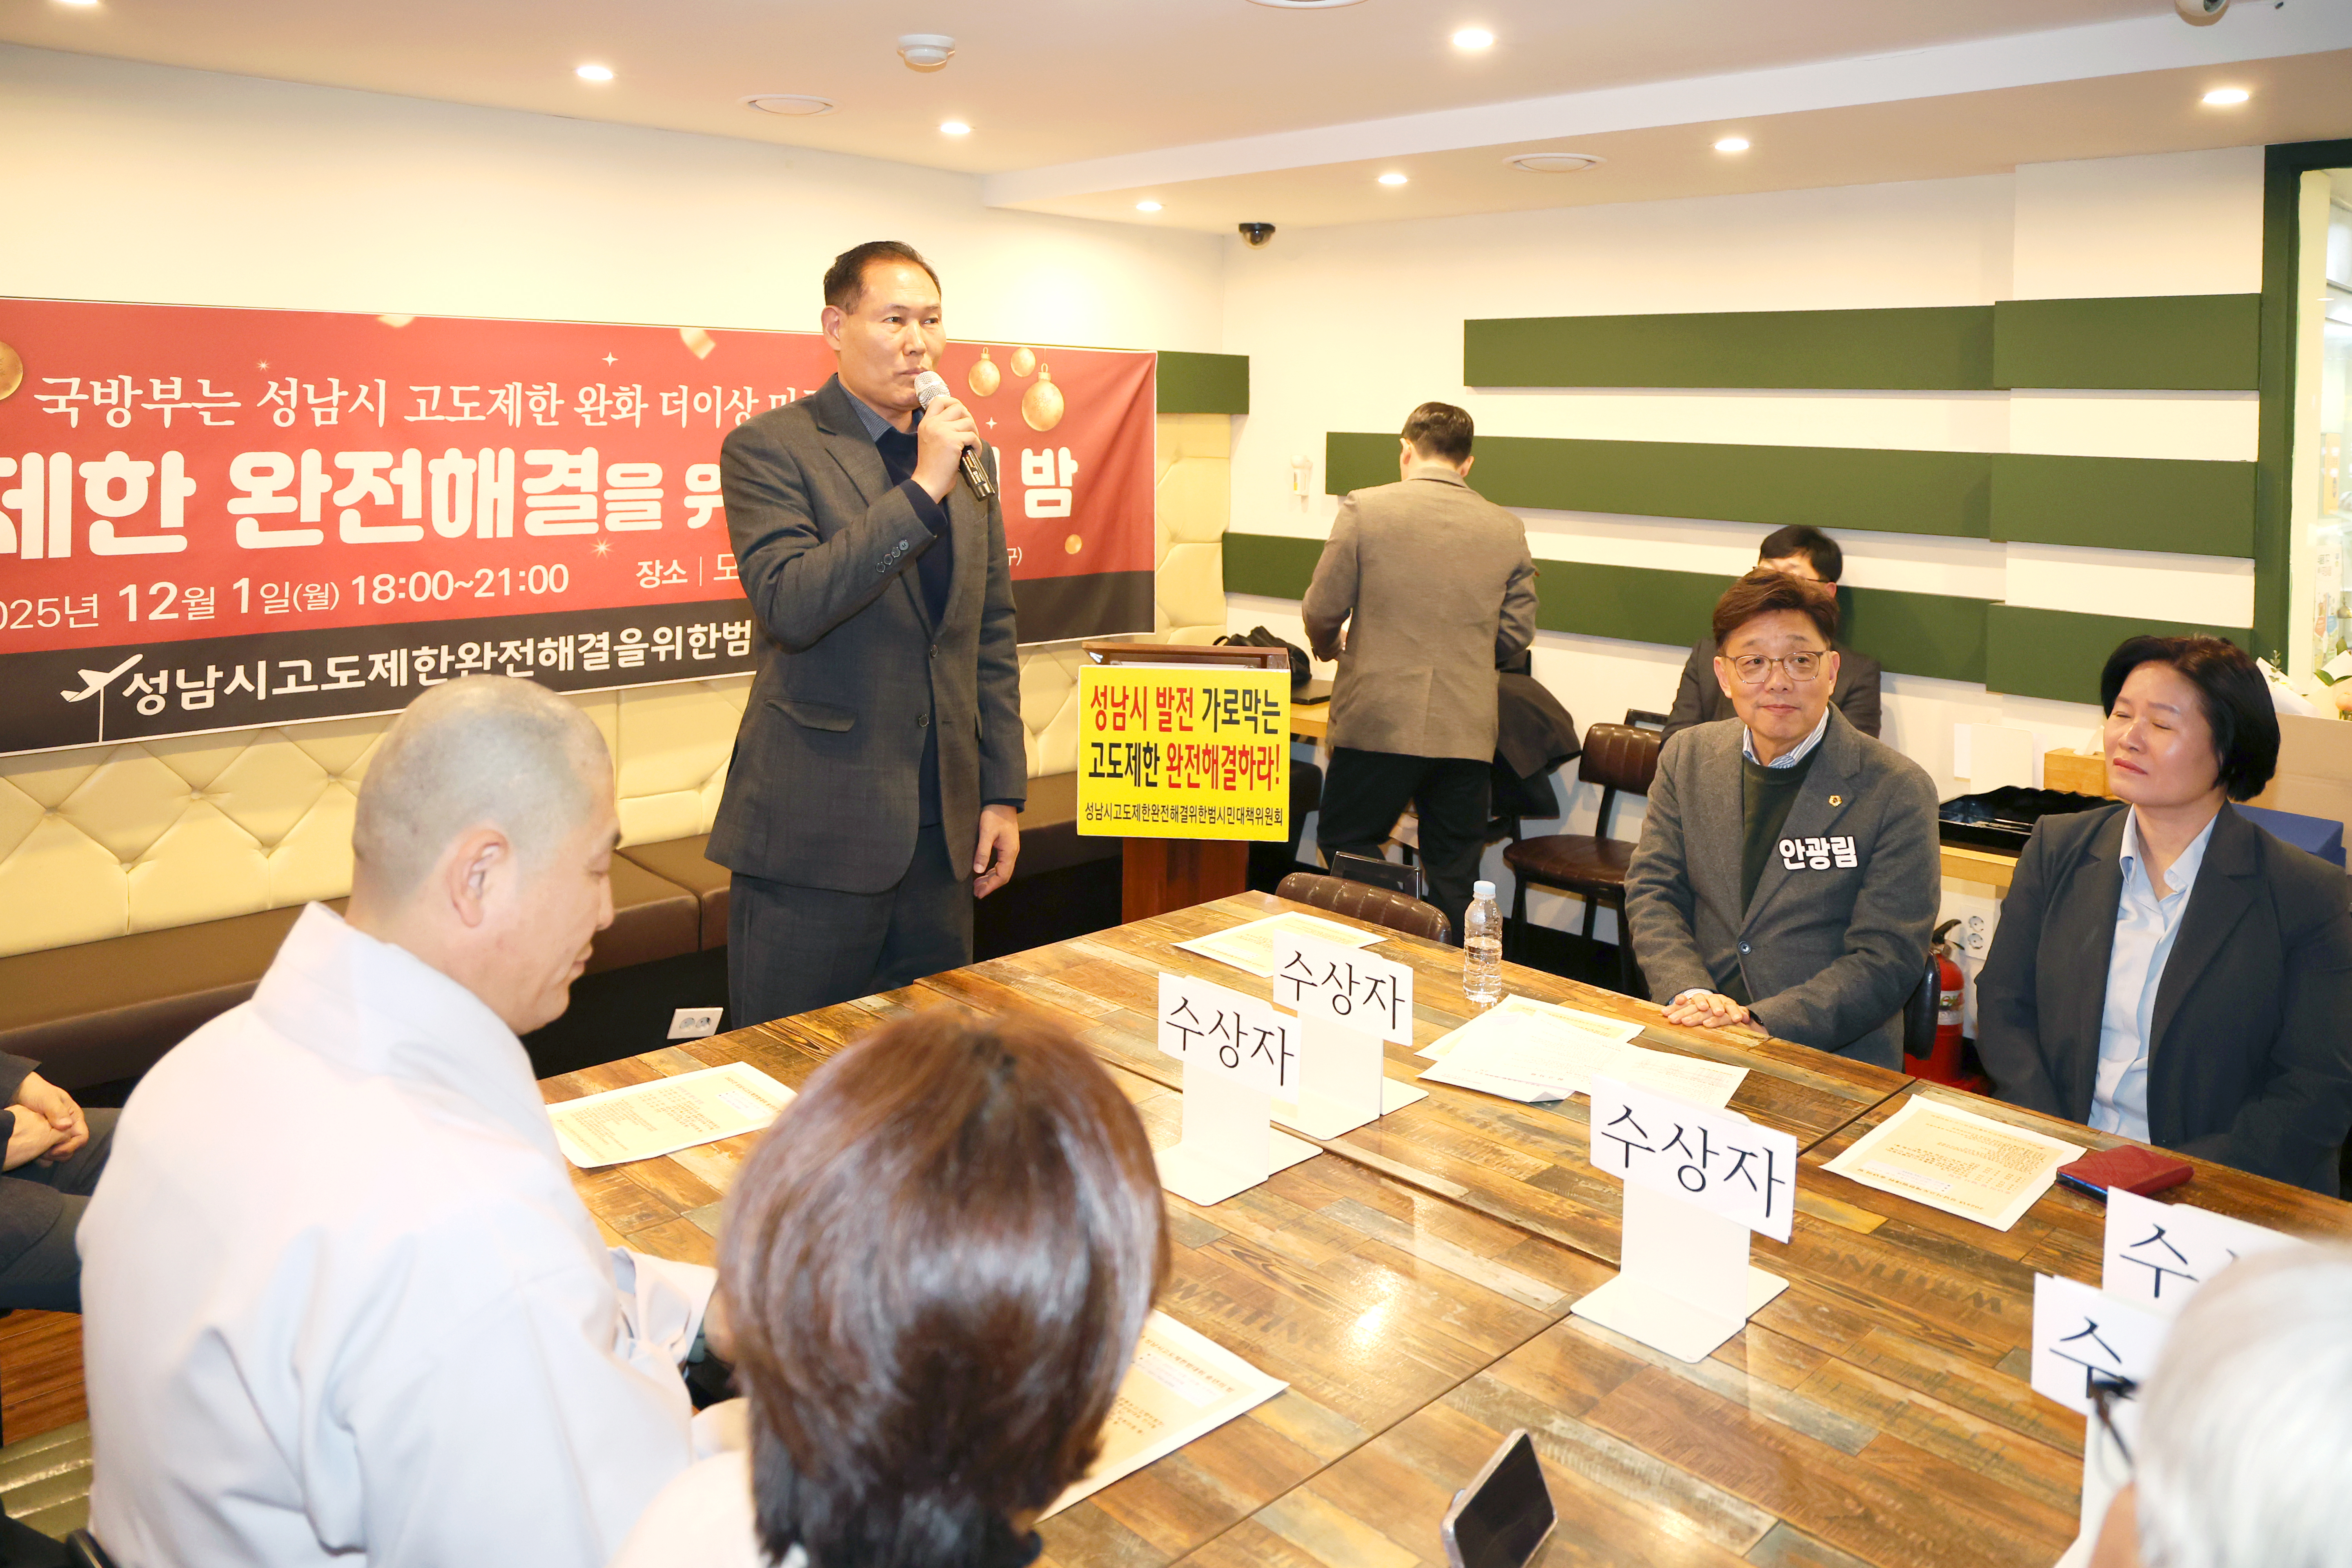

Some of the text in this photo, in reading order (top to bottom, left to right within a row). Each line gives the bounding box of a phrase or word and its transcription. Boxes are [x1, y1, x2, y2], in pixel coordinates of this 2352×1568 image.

[34, 374, 242, 428] 국방부는
[256, 376, 387, 428] 성남시
[404, 381, 564, 428] 고도제한
[573, 382, 649, 428] 완화
[659, 384, 760, 428] 더이상
[227, 447, 664, 549] 완전해결을
[1021, 446, 1078, 518] 밤
[119, 581, 215, 622] 12월
[232, 577, 340, 615] 1일(월)
[351, 563, 569, 606] 18:00~21:00
[635, 559, 688, 589] 장소
[122, 619, 752, 717] 성남시고도제한완전해결을위한범
[1090, 685, 1281, 734] 성남시 발전 가로막는
[1088, 741, 1280, 791] 고도제한 완전해결하라!
[1085, 802, 1283, 826] 성남시고도제한완전해결위한범시민대책위원회
[1779, 835, 1858, 871] 안광림
[1279, 950, 1405, 1030] 수상자
[1166, 996, 1295, 1087] 수상자
[1601, 1104, 1786, 1219] 수상자
